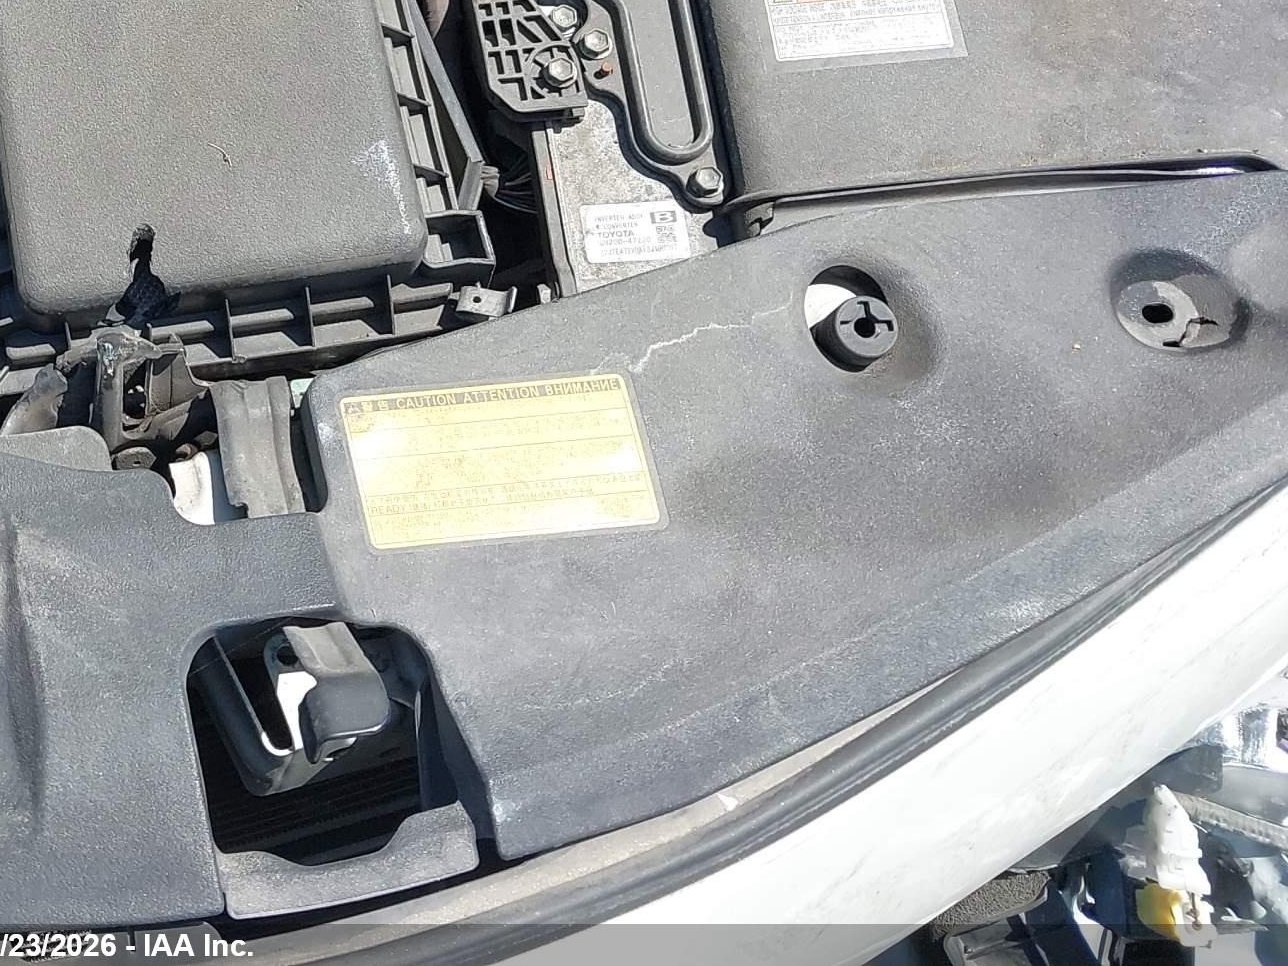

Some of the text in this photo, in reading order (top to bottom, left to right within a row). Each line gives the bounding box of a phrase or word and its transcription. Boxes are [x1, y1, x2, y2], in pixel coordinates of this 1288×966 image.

[597, 229, 634, 239] TOYOTA
[396, 393, 456, 410] CAUTION
[463, 386, 540, 404] ATTENTION
